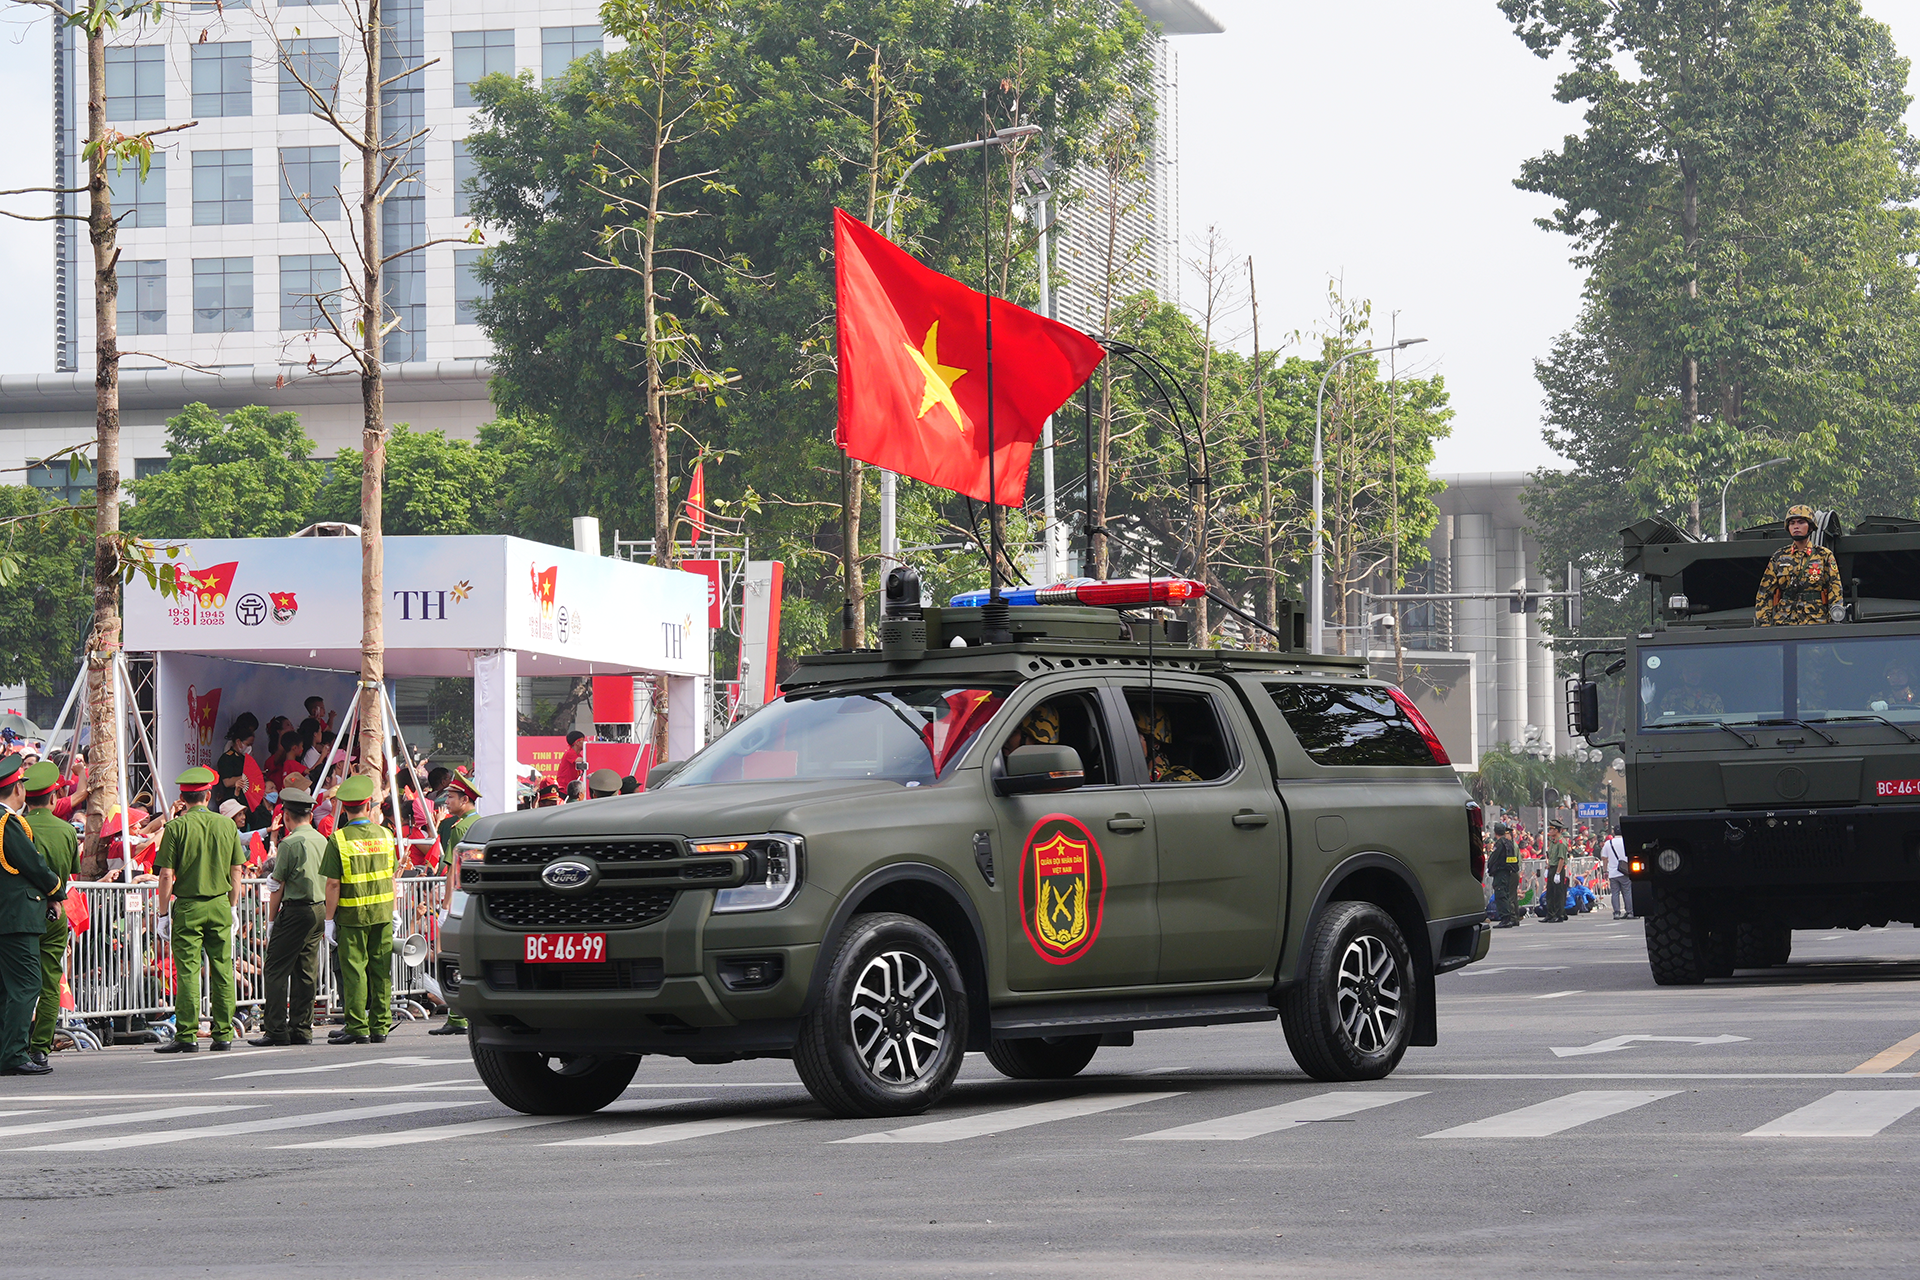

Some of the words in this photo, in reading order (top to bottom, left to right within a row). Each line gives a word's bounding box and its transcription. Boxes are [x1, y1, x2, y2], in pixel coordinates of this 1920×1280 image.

[200, 593, 226, 609] 80
[393, 591, 448, 620] TH
[200, 610, 225, 618] 1945
[661, 621, 683, 659] TH
[200, 725, 213, 746] 80
[532, 751, 551, 760] TINH
[552, 867, 580, 882] Ford
[526, 936, 604, 960] BC-46-99
